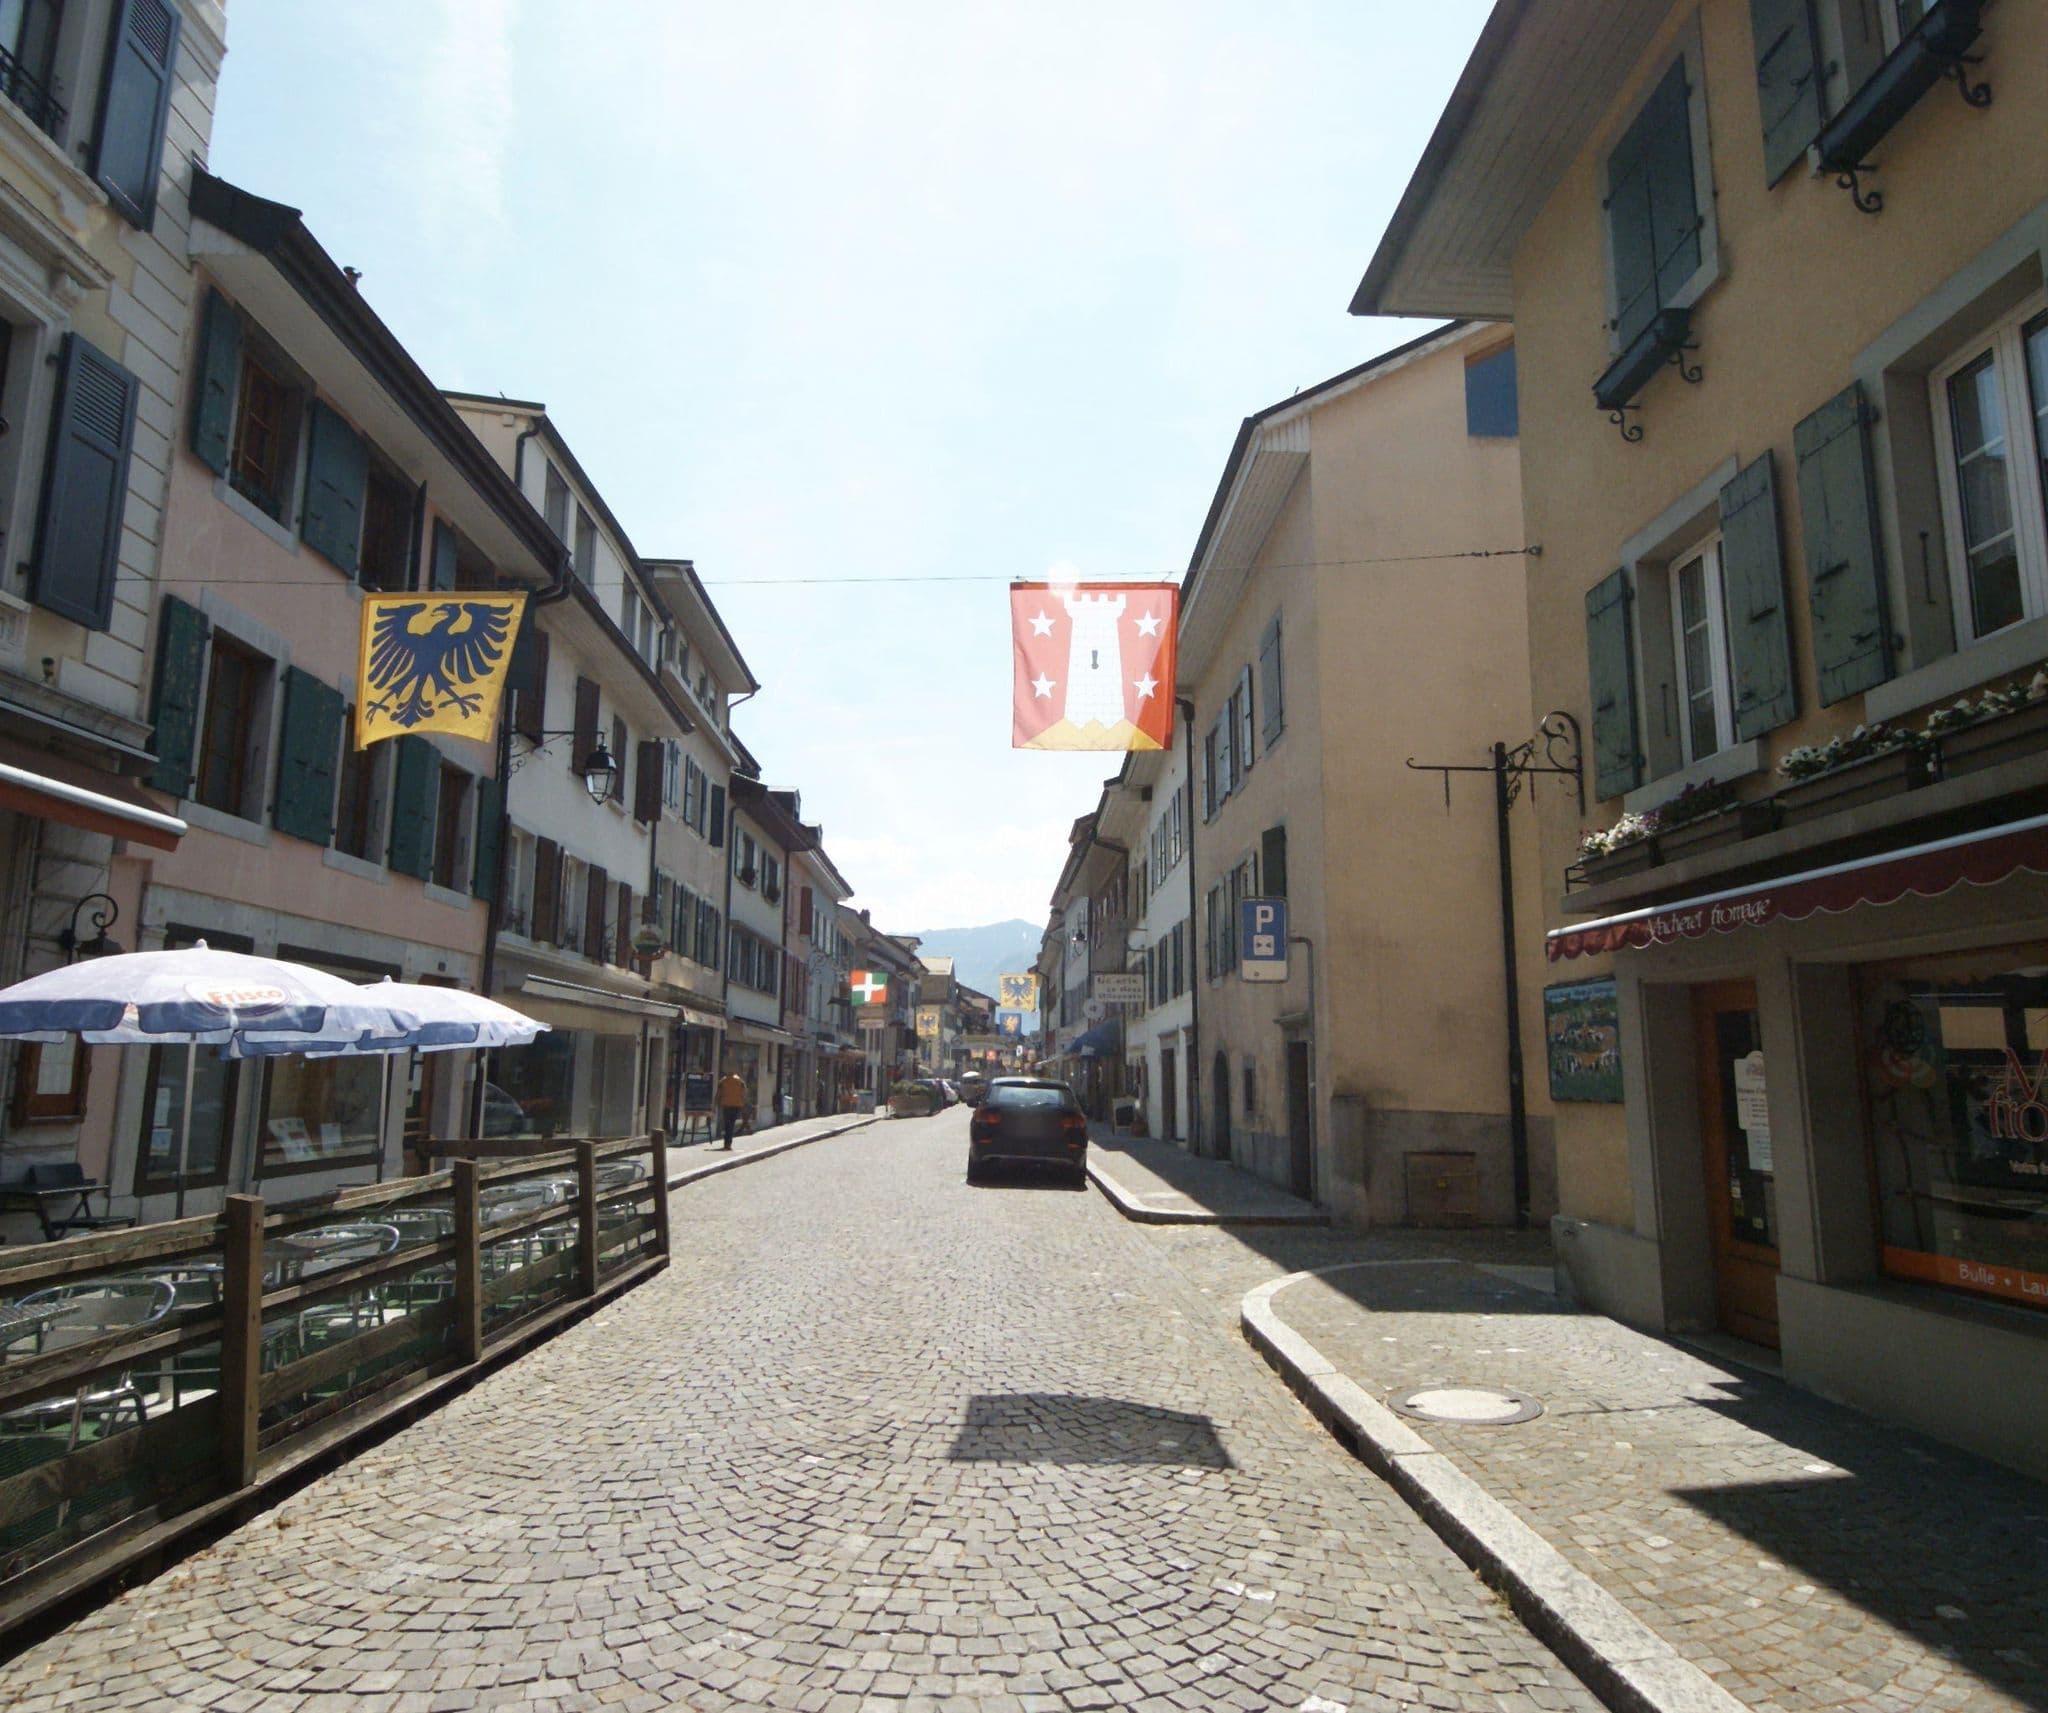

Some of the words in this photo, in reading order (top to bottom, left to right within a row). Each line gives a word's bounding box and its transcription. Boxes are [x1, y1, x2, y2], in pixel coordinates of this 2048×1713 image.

[1256, 905, 1274, 933] P
[207, 989, 282, 1005] Frisco
[1959, 1263, 1995, 1286] Bulle
